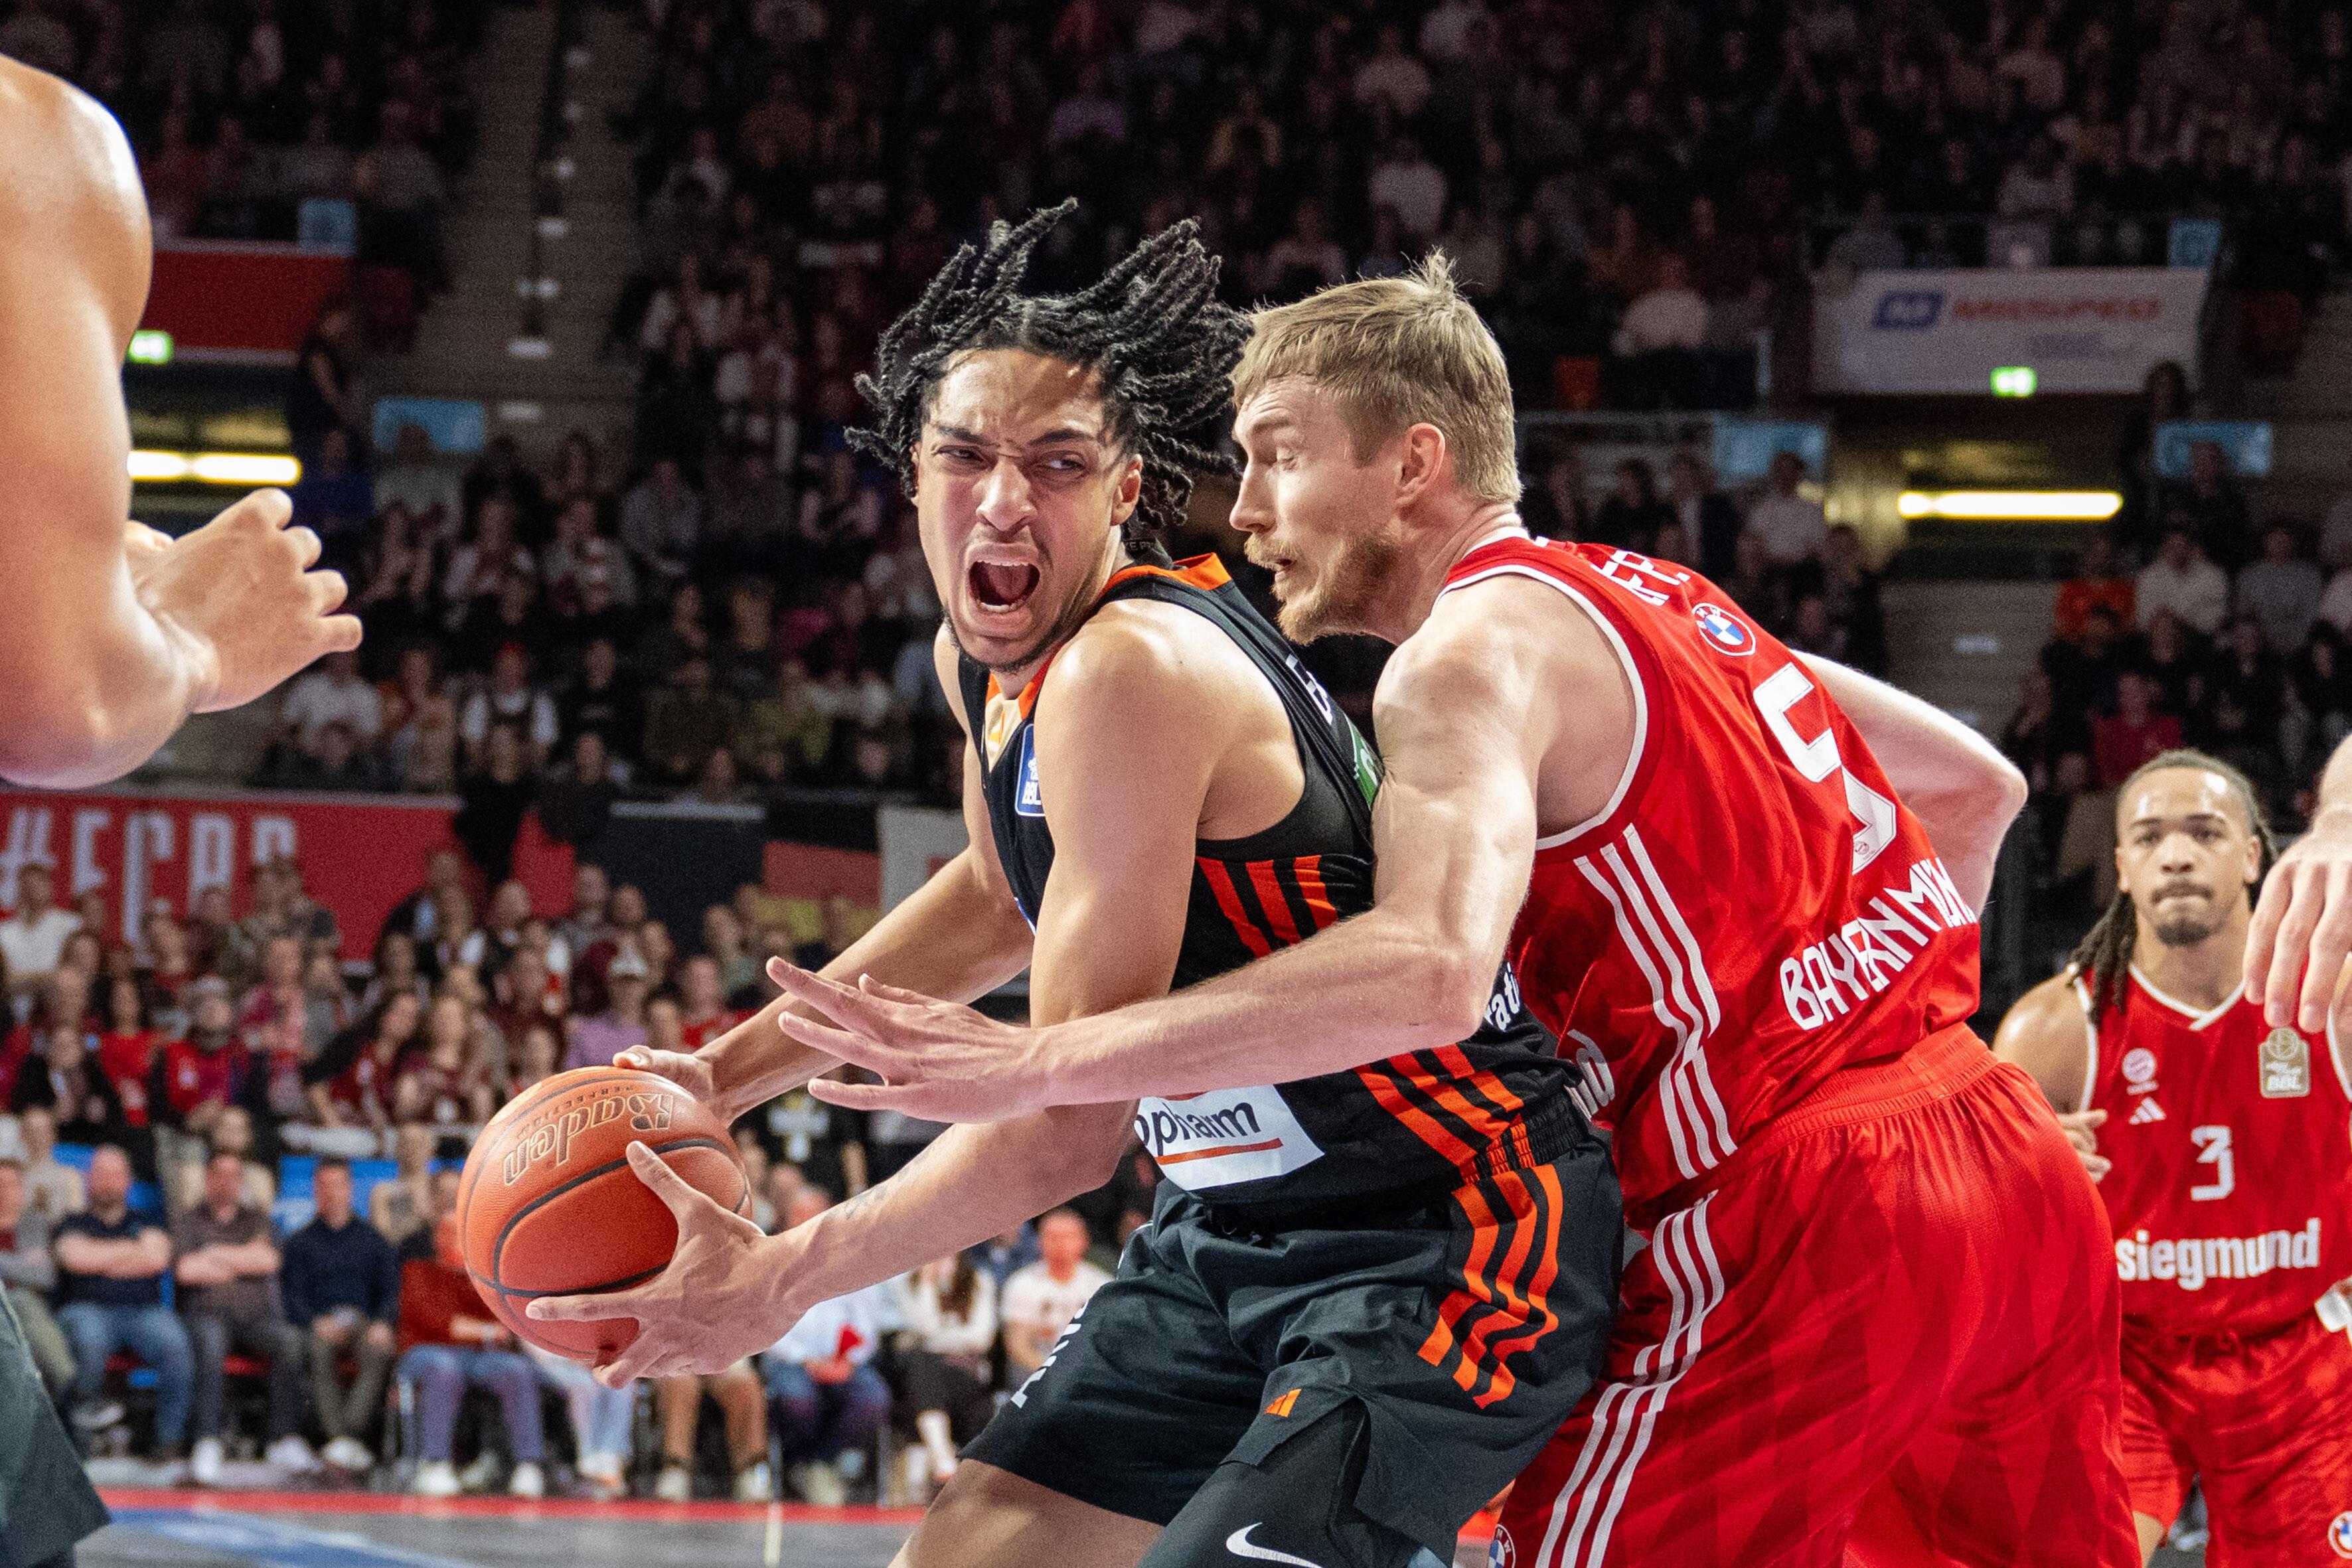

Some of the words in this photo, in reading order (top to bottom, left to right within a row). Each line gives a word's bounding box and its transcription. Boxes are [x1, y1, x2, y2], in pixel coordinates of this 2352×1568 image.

[1753, 662, 1897, 876] 5
[503, 1093, 674, 1186] Baden
[2191, 1125, 2235, 1202] 3
[2115, 1217, 2321, 1291] siegmund
